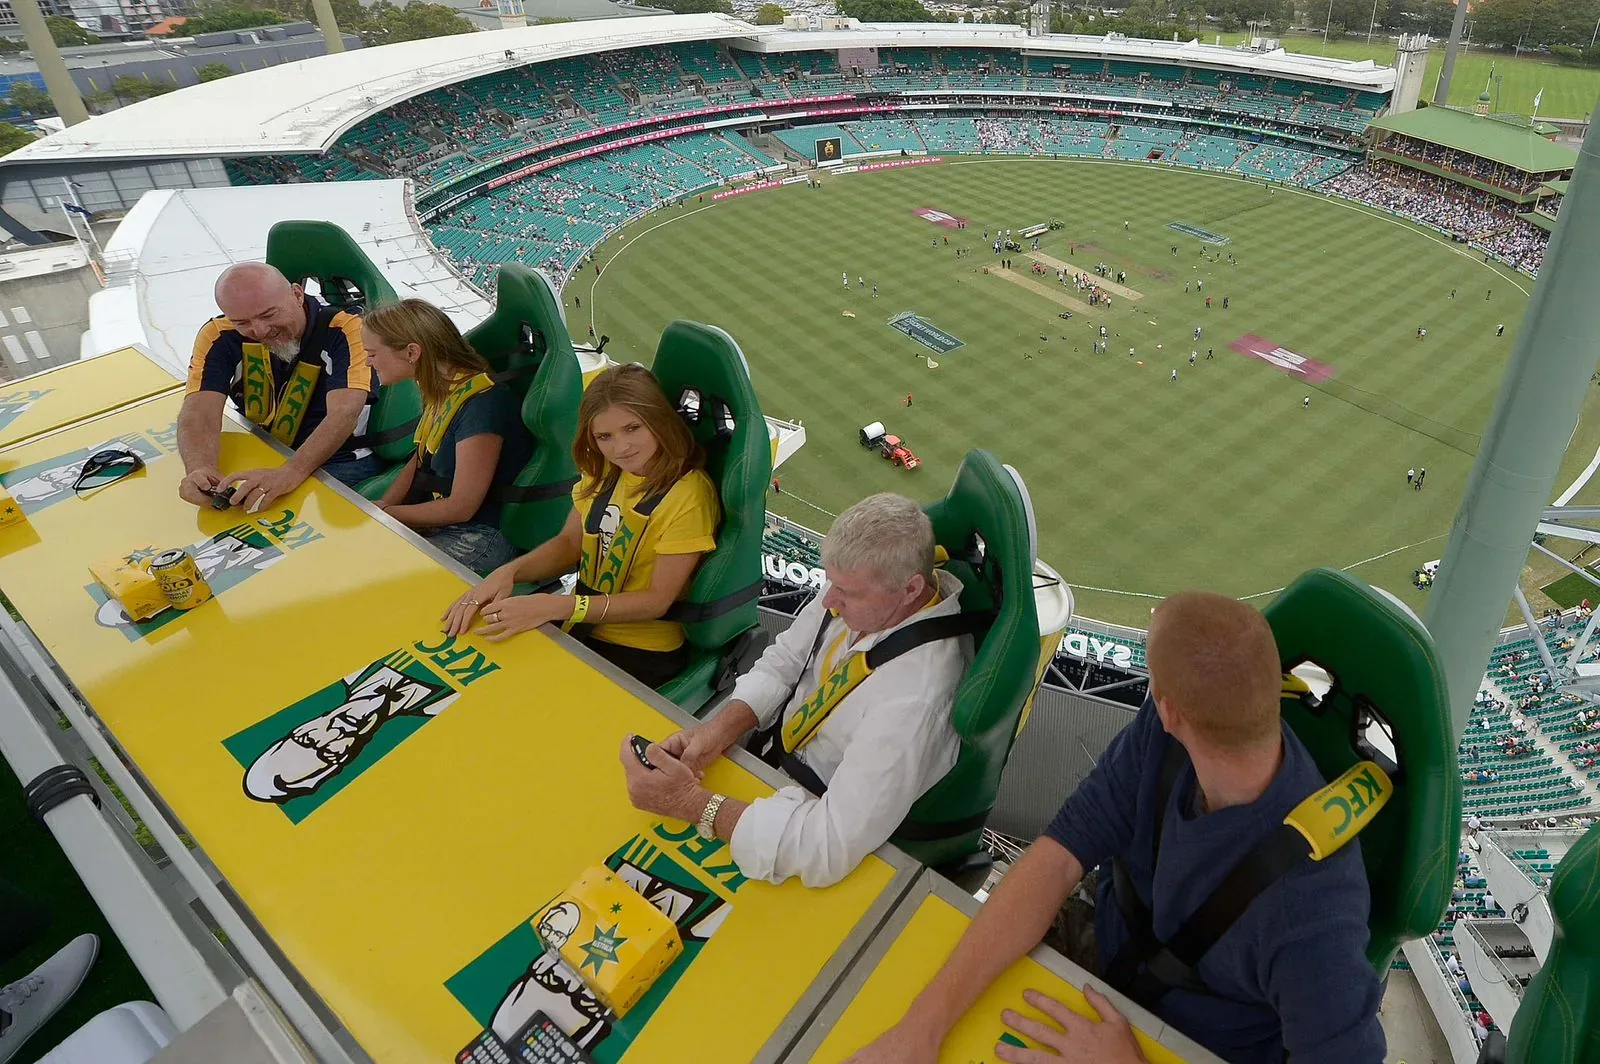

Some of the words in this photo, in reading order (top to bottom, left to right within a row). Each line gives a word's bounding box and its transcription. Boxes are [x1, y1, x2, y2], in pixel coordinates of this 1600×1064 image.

[247, 354, 266, 415] KFC
[277, 375, 313, 436] KFC
[257, 509, 326, 550] KFC
[599, 523, 635, 595] KFC
[414, 630, 502, 687] KFC
[791, 662, 850, 737] KFC
[1322, 767, 1384, 836] KFC
